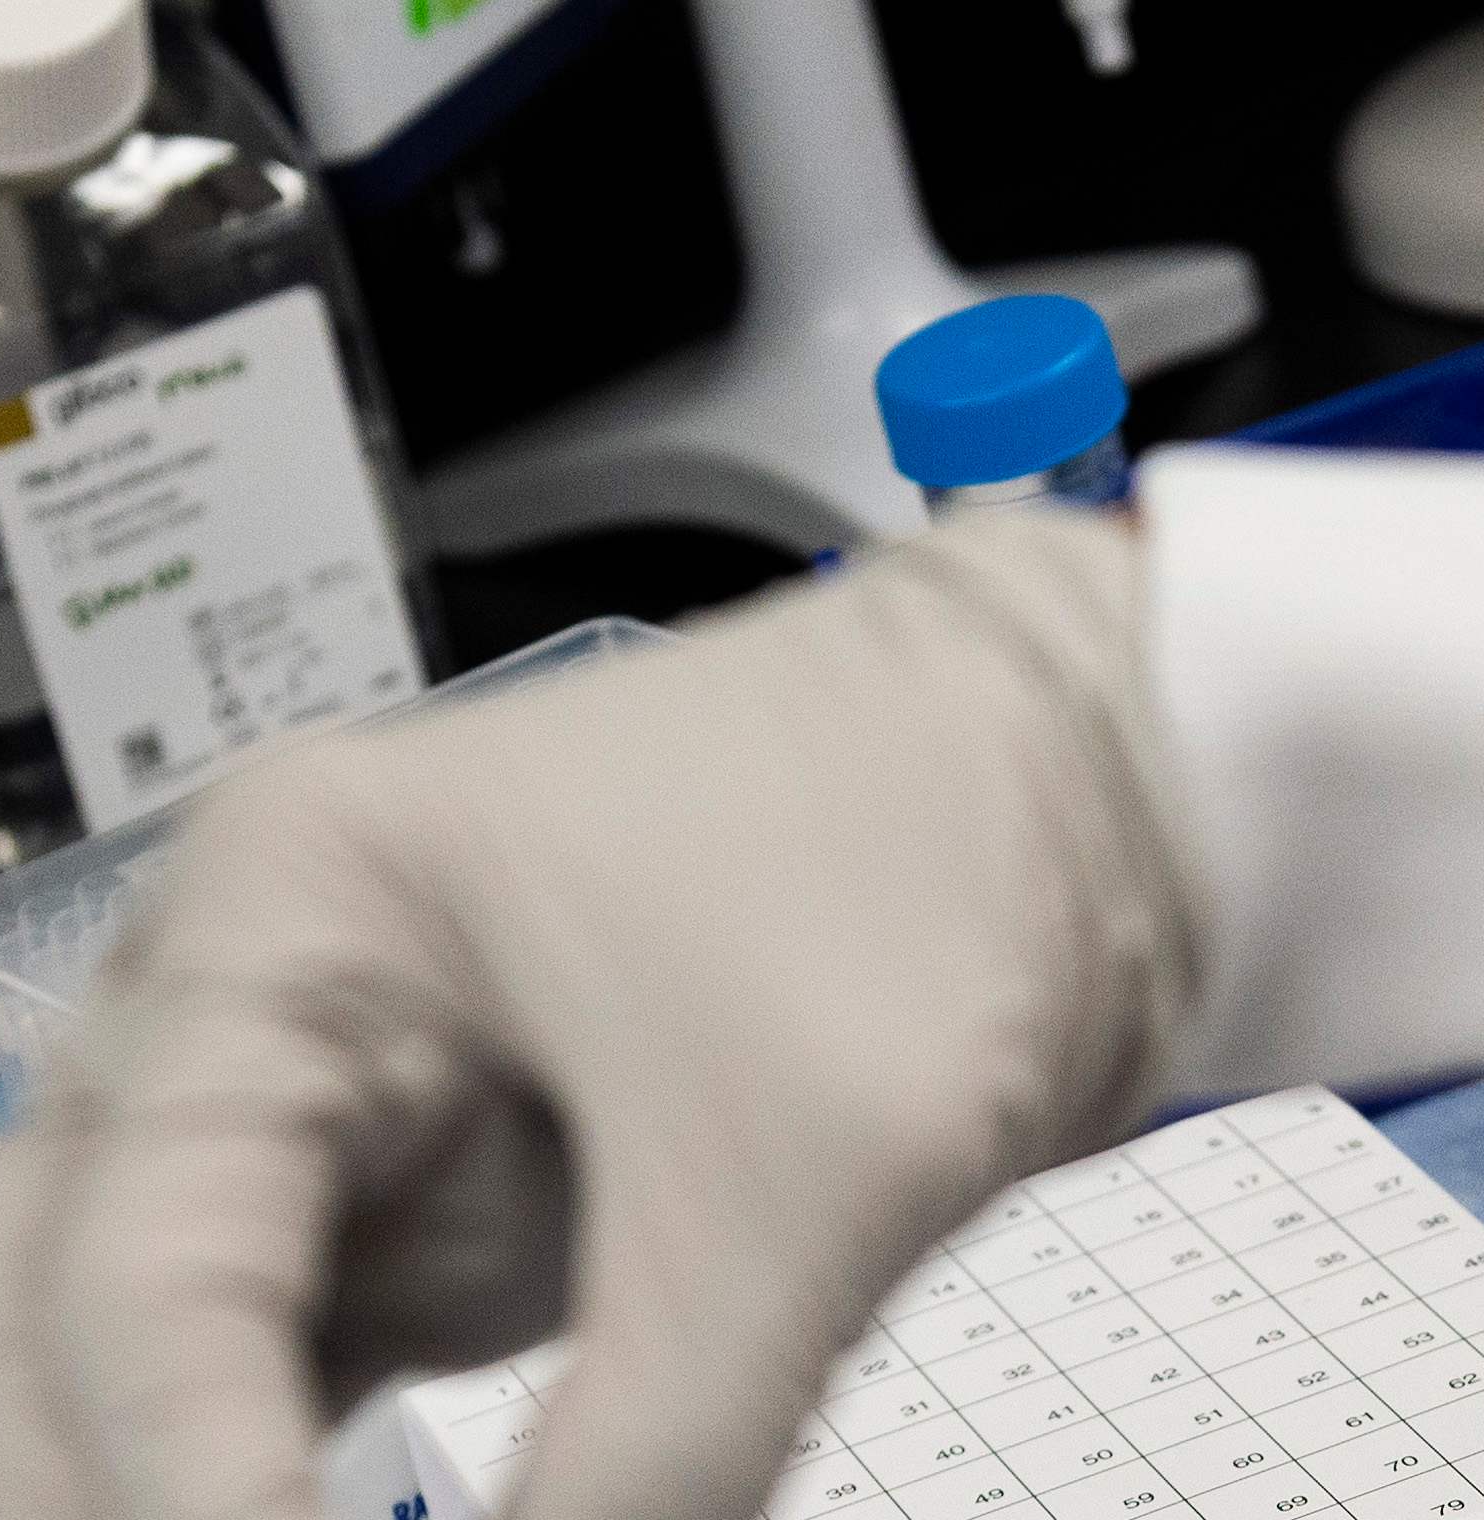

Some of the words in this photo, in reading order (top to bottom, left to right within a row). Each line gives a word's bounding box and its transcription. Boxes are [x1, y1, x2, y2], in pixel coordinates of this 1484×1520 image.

[859, 1357, 891, 1378] 22
[963, 1322, 996, 1341] 23
[1067, 1285, 1099, 1304] 24
[899, 1400, 931, 1418] 31
[1001, 1363, 1034, 1381] 32
[1106, 1326, 1140, 1344] 33
[1211, 1288, 1243, 1306] 34
[1315, 1251, 1348, 1268] 35
[509, 1426, 537, 1445] 10
[825, 1482, 859, 1501] 39
[935, 1443, 967, 1462] 40
[1047, 1404, 1076, 1421] 41
[1149, 1367, 1181, 1384] 42
[1255, 1329, 1287, 1346] 43
[1360, 1290, 1390, 1308] 44
[974, 1487, 1006, 1505] 49
[1081, 1448, 1115, 1467] 50
[1193, 1408, 1224, 1426] 51
[1296, 1370, 1330, 1388] 52
[1401, 1331, 1436, 1349] 53
[1122, 1491, 1156, 1511] 59
[1231, 1451, 1266, 1470] 60
[1344, 1410, 1376, 1429] 61
[1447, 1372, 1482, 1391] 62
[1275, 1494, 1310, 1513] 69
[1383, 1454, 1420, 1473] 70
[1429, 1498, 1467, 1517] 79
